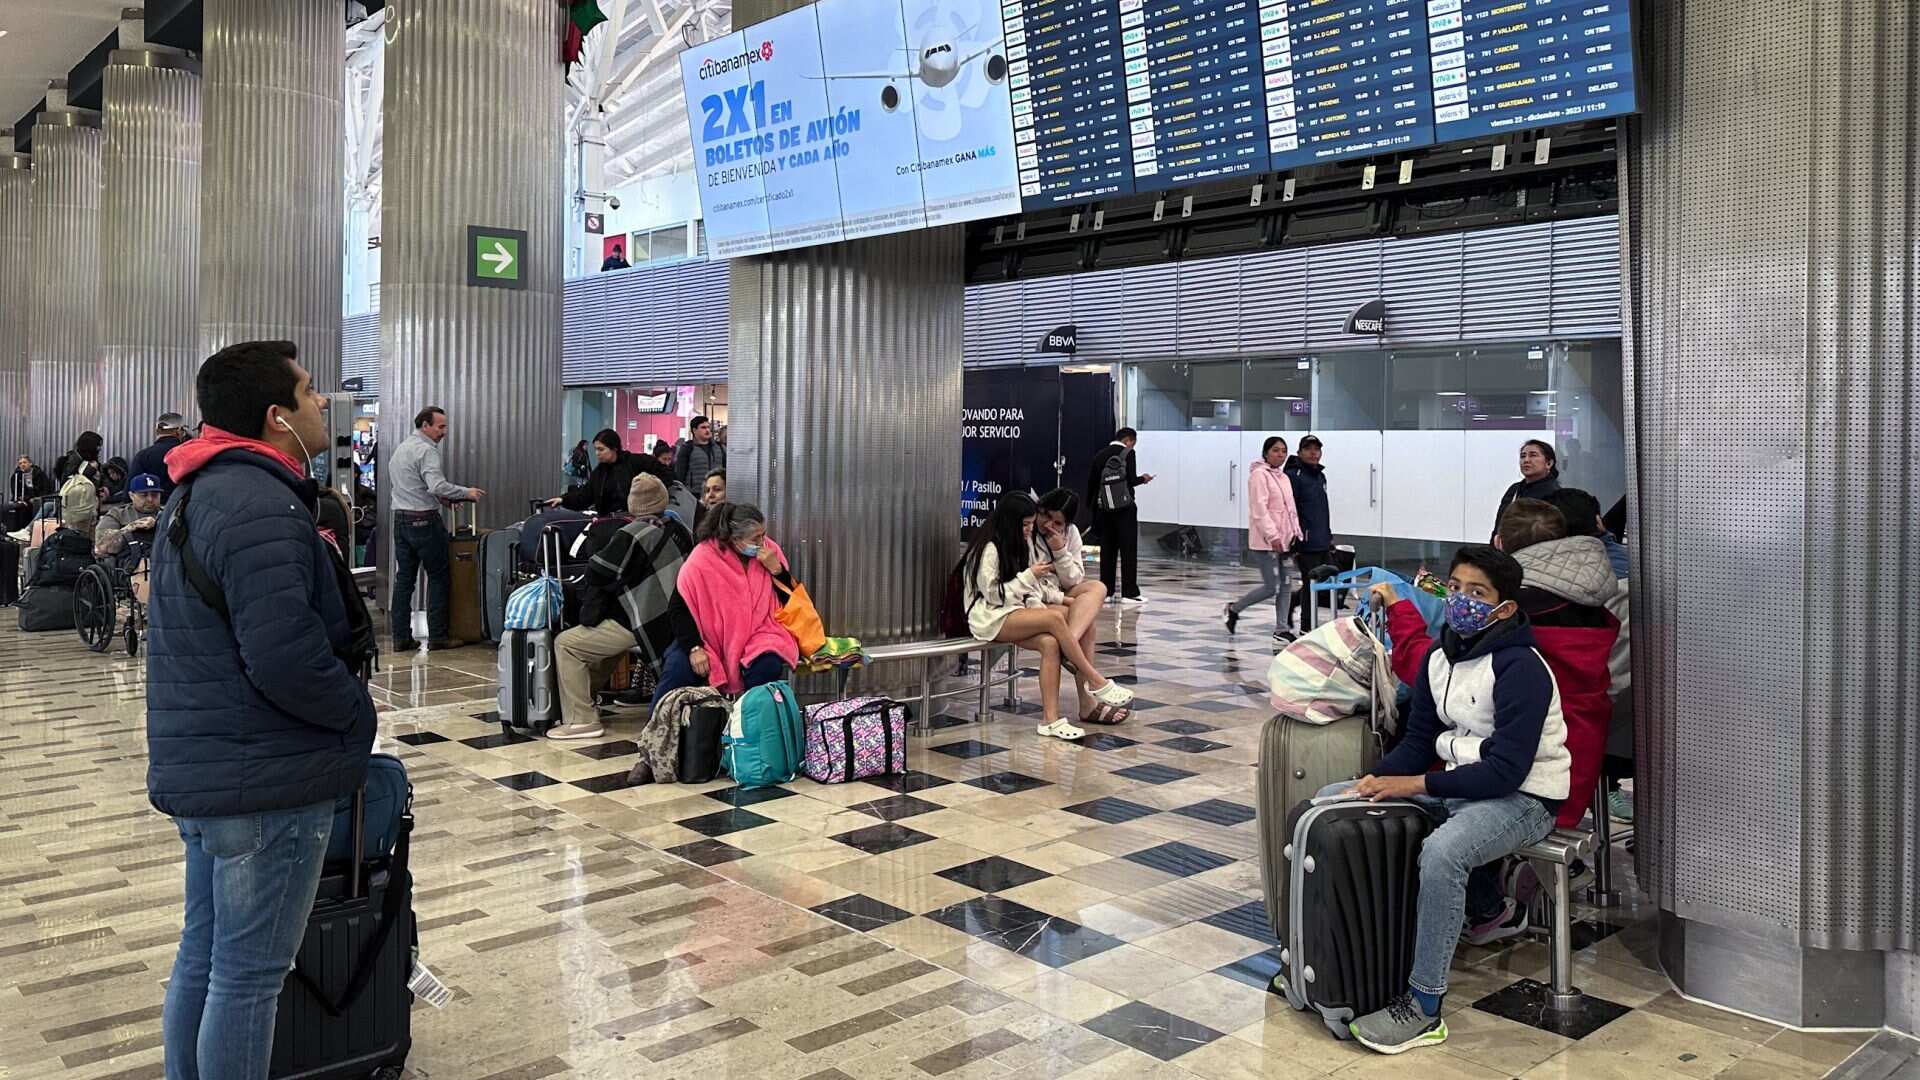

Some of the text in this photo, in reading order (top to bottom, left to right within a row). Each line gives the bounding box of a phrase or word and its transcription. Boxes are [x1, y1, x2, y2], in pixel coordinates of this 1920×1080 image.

[1594, 5, 1608, 13] TIME
[1494, 44, 1518, 53] CANCUN
[1595, 25, 1610, 33] TIME
[699, 48, 762, 80] citibanamex
[1495, 62, 1520, 71] CANCUN
[1596, 43, 1611, 51] TIME
[1498, 97, 1533, 107] GUATEMALA
[1588, 82, 1617, 92] DELAYED
[701, 80, 792, 143] 2X1 EN
[1490, 119, 1513, 128] viernes
[1528, 110, 1560, 121] diciembre
[1565, 105, 1581, 115] 2023
[1587, 102, 1606, 112] 11:19
[706, 106, 860, 167] BOLETOS DE AVIÓN
[708, 138, 850, 187] DE BIENVENIDA Y CADA AÑO
[896, 144, 996, 176] Con Citibanamex GANA MÁS
[1355, 317, 1383, 331] NESCAFÉ
[1050, 336, 1075, 346] BBVA
[1000, 408, 1024, 420] PARA
[980, 426, 1020, 438] SERVICIO
[972, 480, 1002, 494] Pasillo
[992, 500, 997, 510] 1
